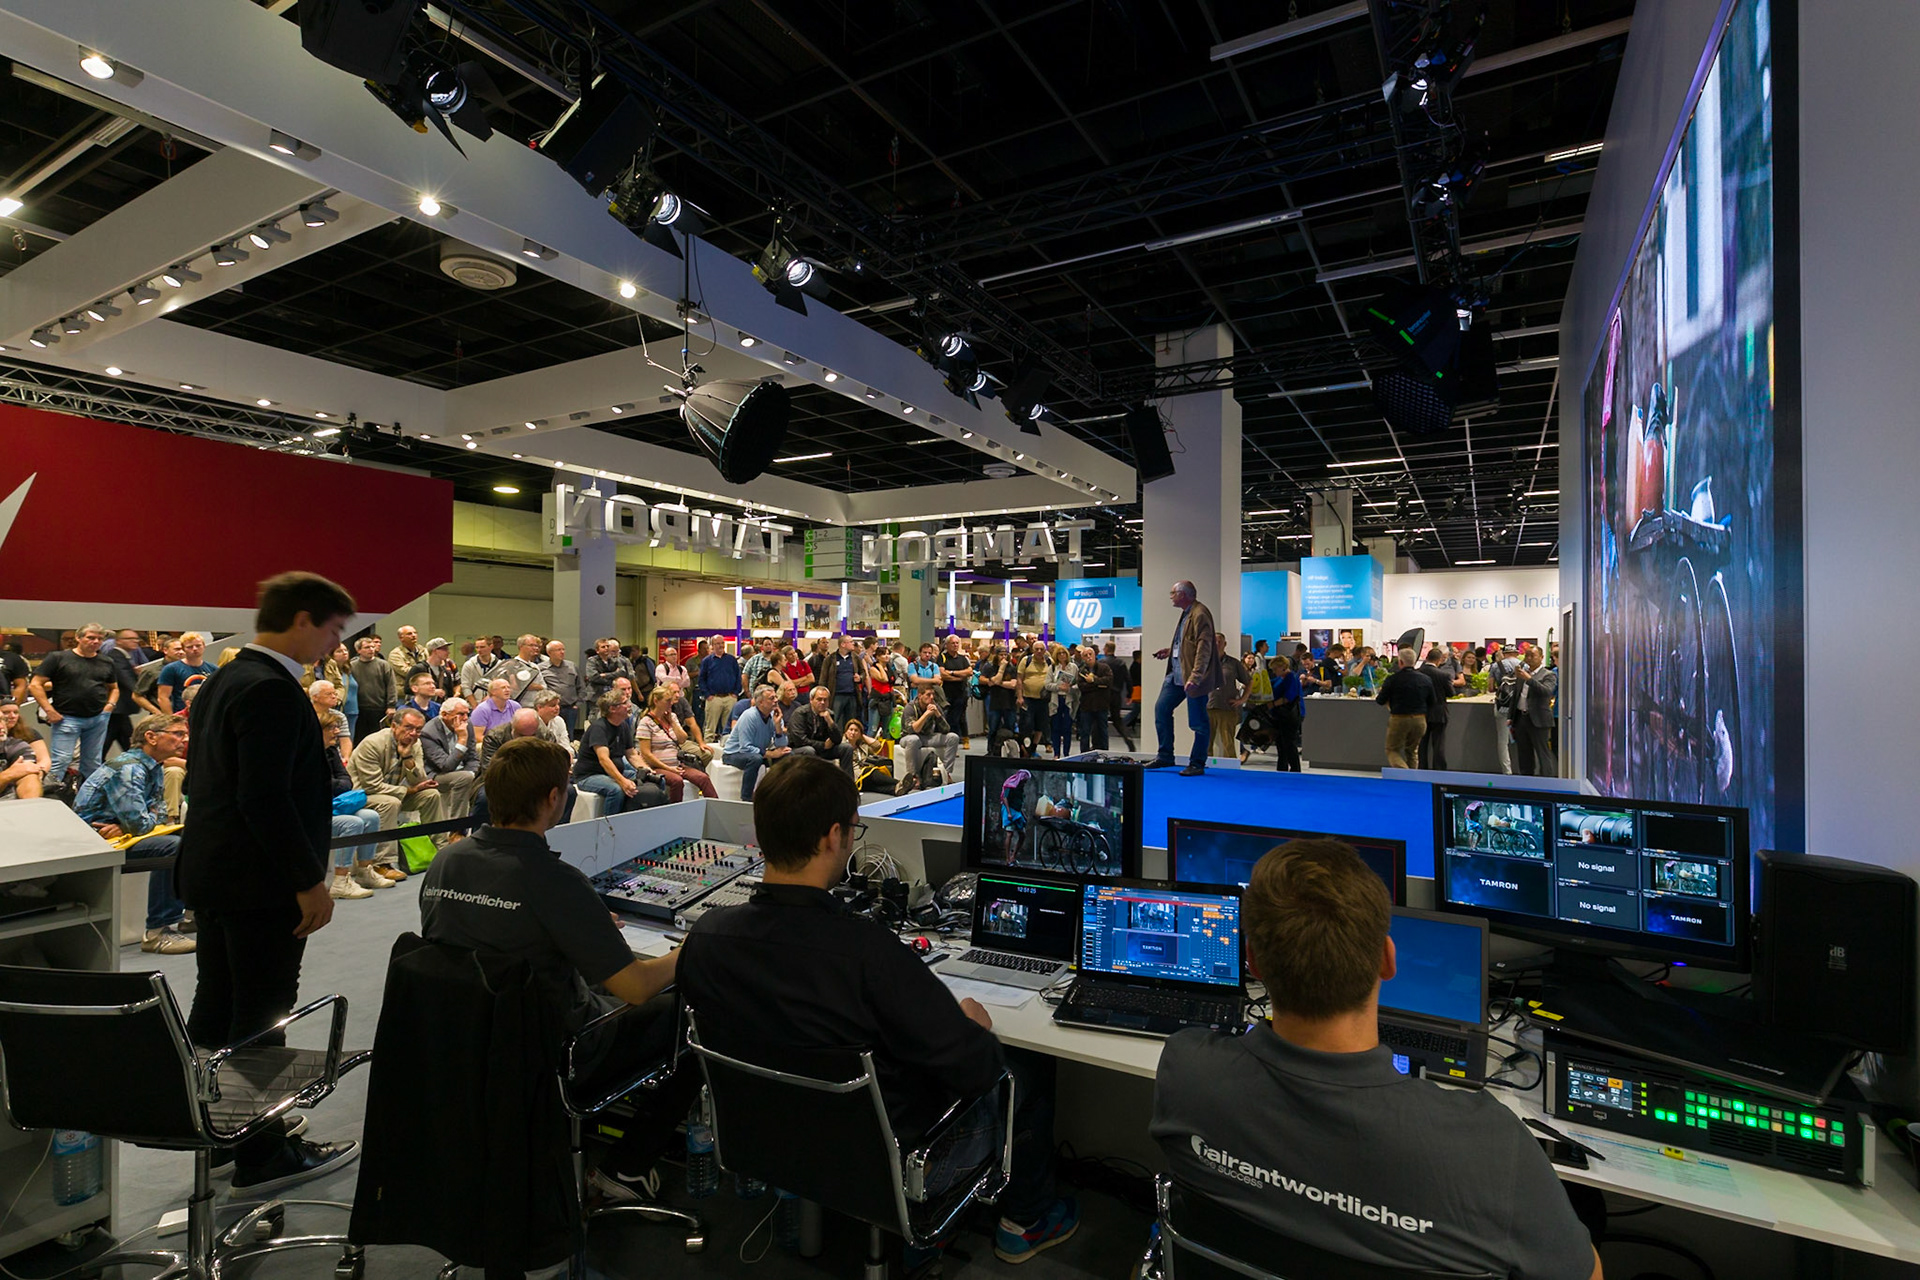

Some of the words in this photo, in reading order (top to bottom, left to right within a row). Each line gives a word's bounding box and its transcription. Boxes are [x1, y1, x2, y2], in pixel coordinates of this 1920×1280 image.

[1409, 596, 1457, 610] These
[1462, 598, 1489, 610] are
[1494, 594, 1518, 608] HP
[1578, 861, 1590, 869] No
[1591, 863, 1615, 873] signal
[1479, 878, 1519, 890] TAMRON
[1579, 901, 1591, 910] No
[1592, 903, 1617, 913] signal
[1670, 914, 1703, 925] TAMRON
[1217, 1164, 1264, 1190] success
